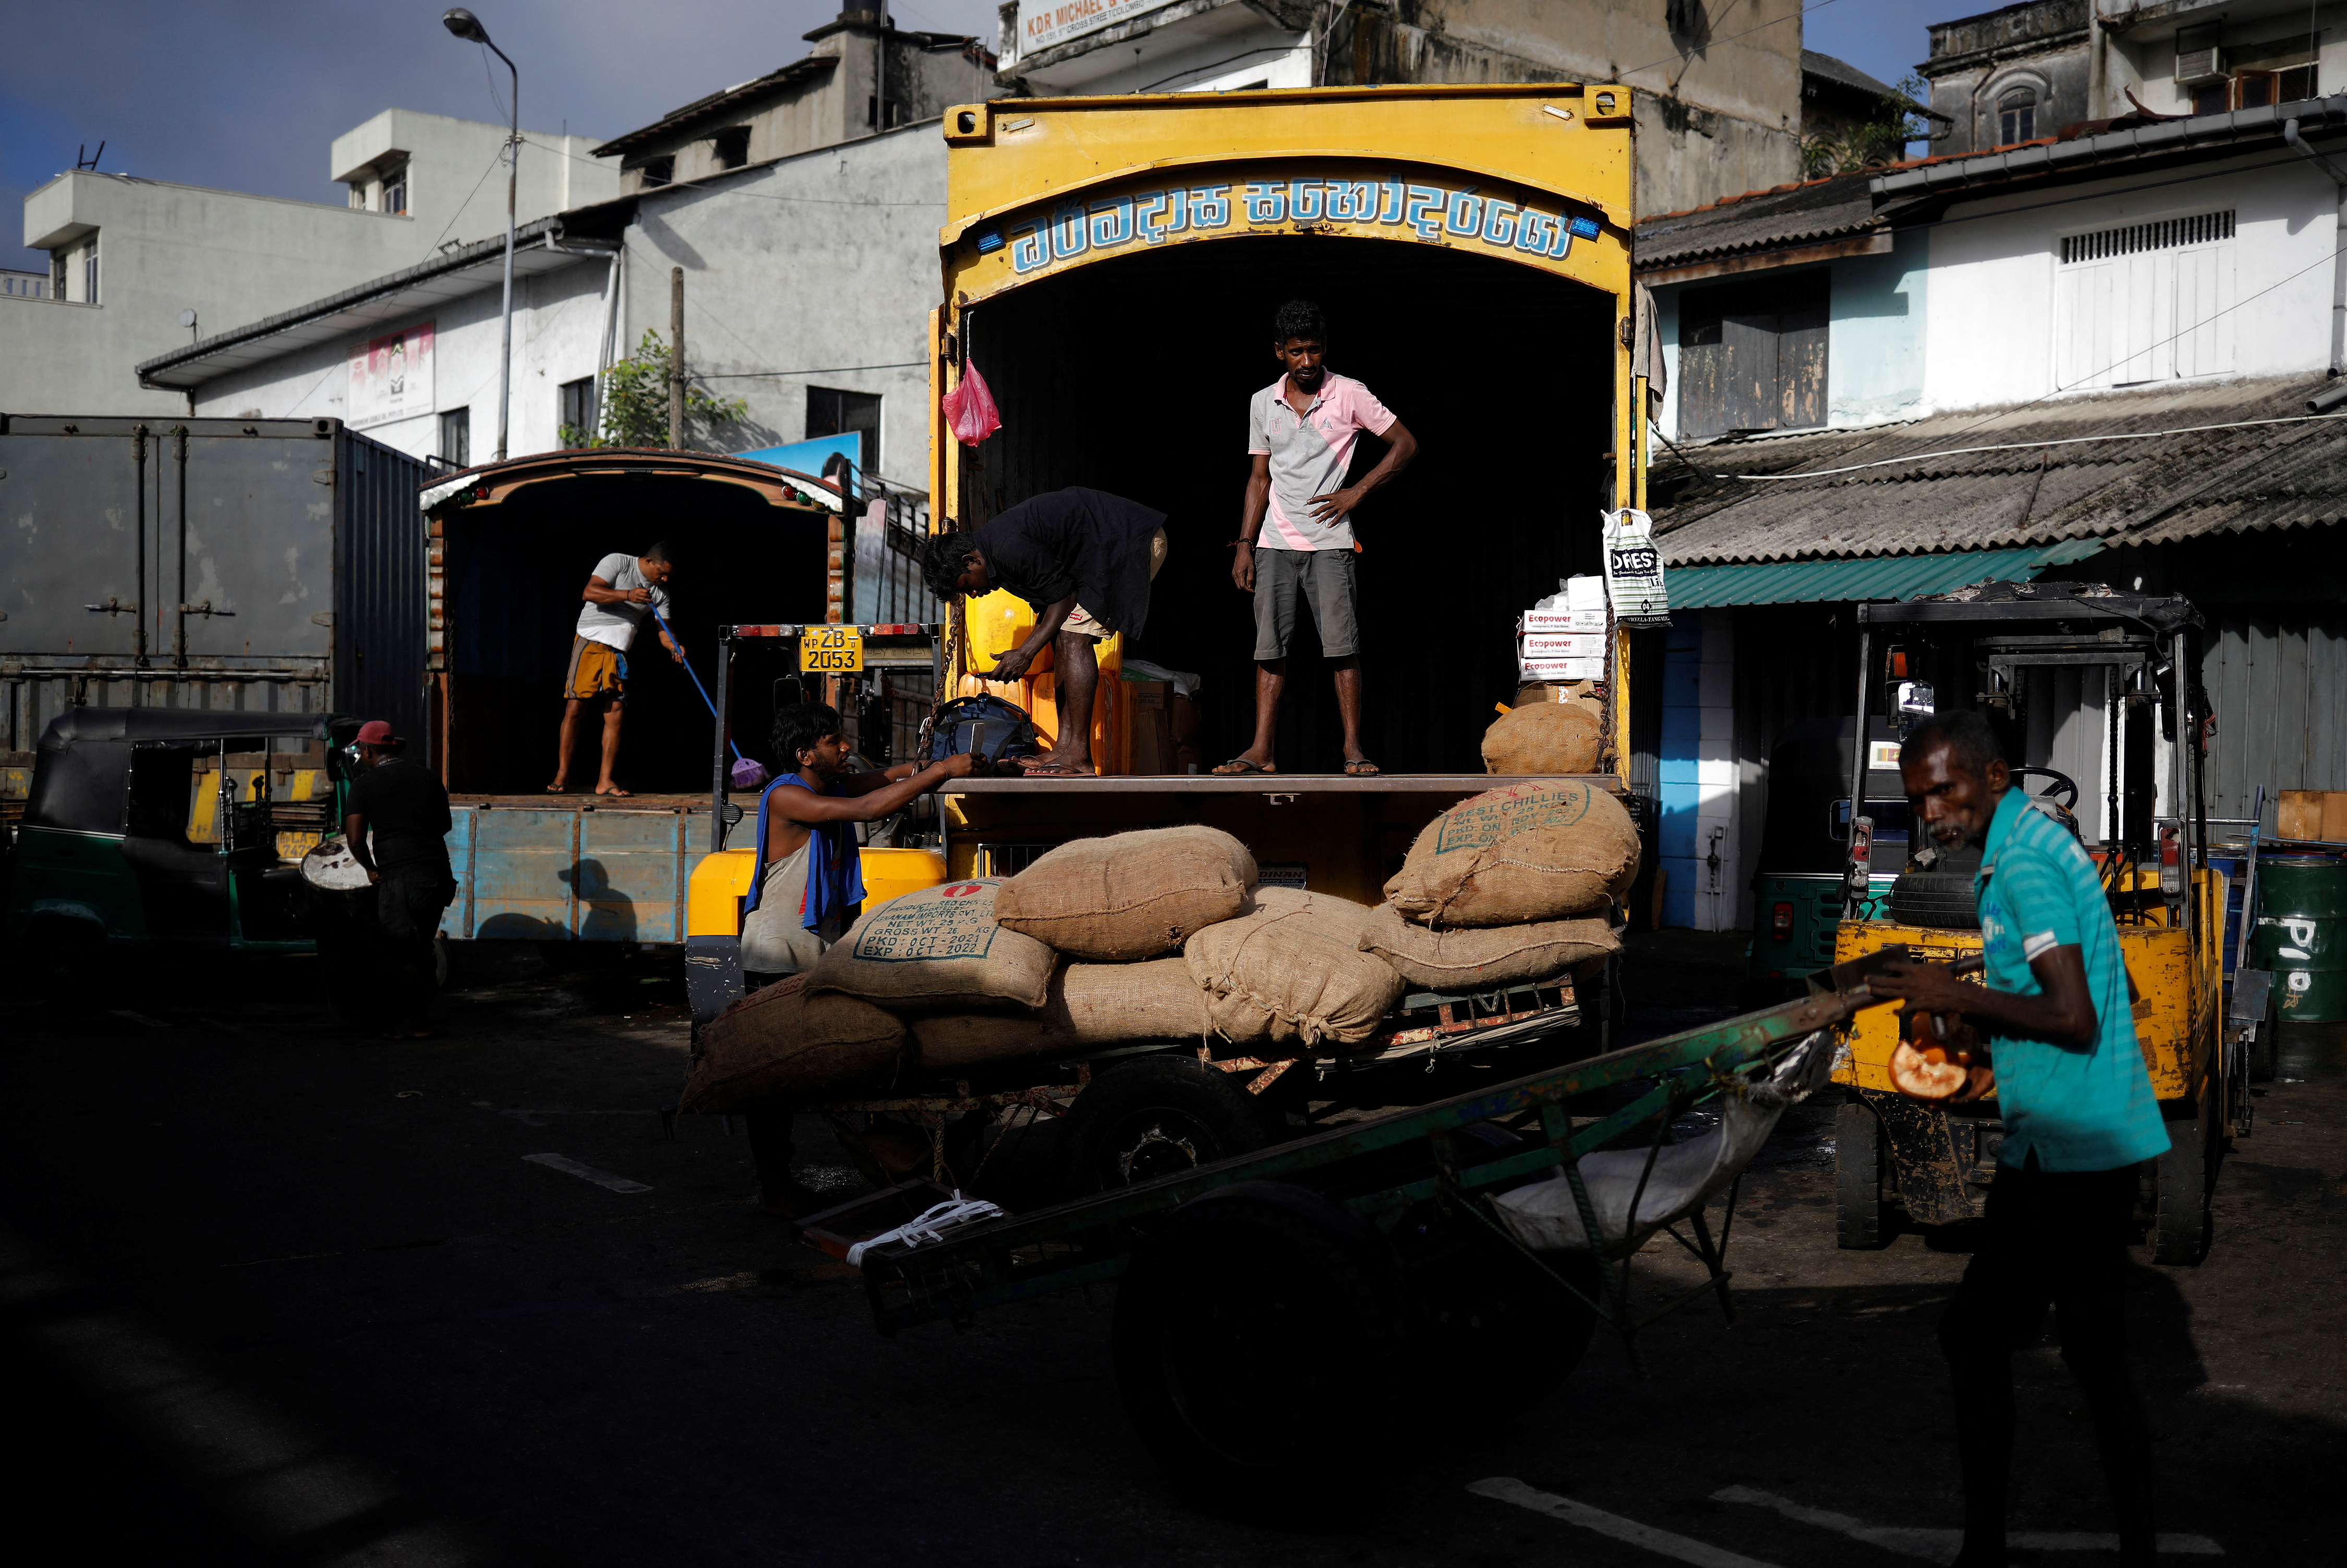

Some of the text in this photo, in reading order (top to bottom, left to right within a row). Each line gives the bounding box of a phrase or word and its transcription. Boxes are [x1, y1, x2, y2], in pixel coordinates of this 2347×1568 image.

[1027, 13, 1052, 37] KDR
[1056, 0, 1103, 27] MICHAEL
[1529, 615, 1571, 623] Ecopower
[804, 638, 818, 648] WP
[821, 629, 845, 648] ZB
[1529, 640, 1571, 649] Ecopower
[808, 650, 855, 668] 2053
[1525, 663, 1567, 671] Ecopower
[1455, 792, 1579, 820] BEST CHILLIES
[1517, 806, 1534, 815] 25
[888, 902, 933, 913] PRODUCT
[914, 911, 954, 920] IMPORTS
[910, 937, 937, 947] OCT
[950, 934, 979, 943] 2021
[906, 946, 936, 956] OCT
[946, 943, 977, 955] 2022
[769, 983, 800, 997] JUN
